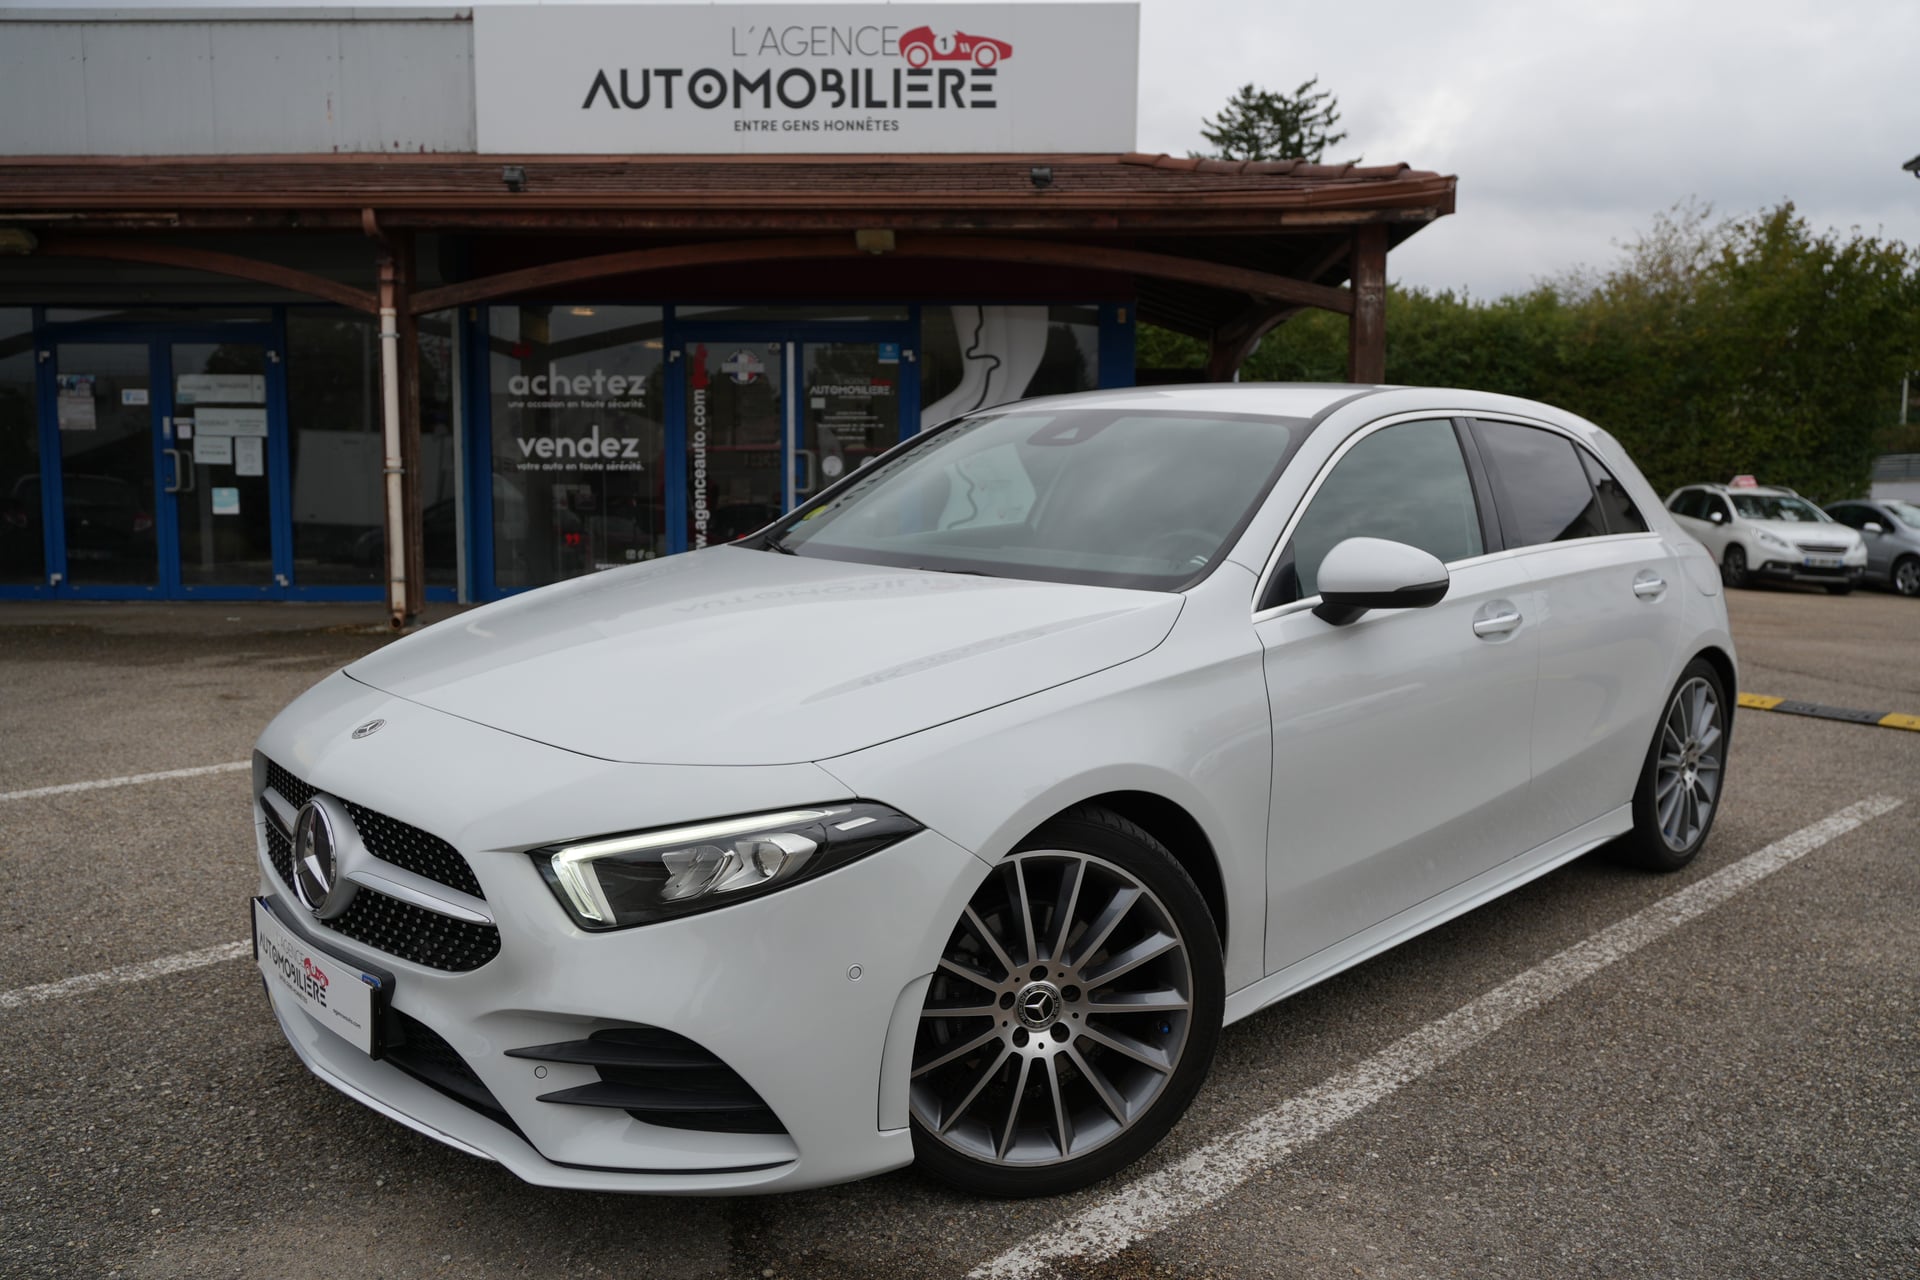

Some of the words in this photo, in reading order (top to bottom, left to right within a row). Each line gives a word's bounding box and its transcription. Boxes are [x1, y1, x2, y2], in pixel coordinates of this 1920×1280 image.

[731, 25, 900, 56] L'AGENCE
[733, 120, 777, 131] ENTRE
[782, 120, 820, 131] GENS
[824, 116, 900, 132] HONNÊTES
[508, 362, 646, 396] achetez
[516, 425, 640, 459] vendez
[516, 462, 539, 471] votre
[542, 462, 564, 471] auto
[579, 462, 604, 471] toute
